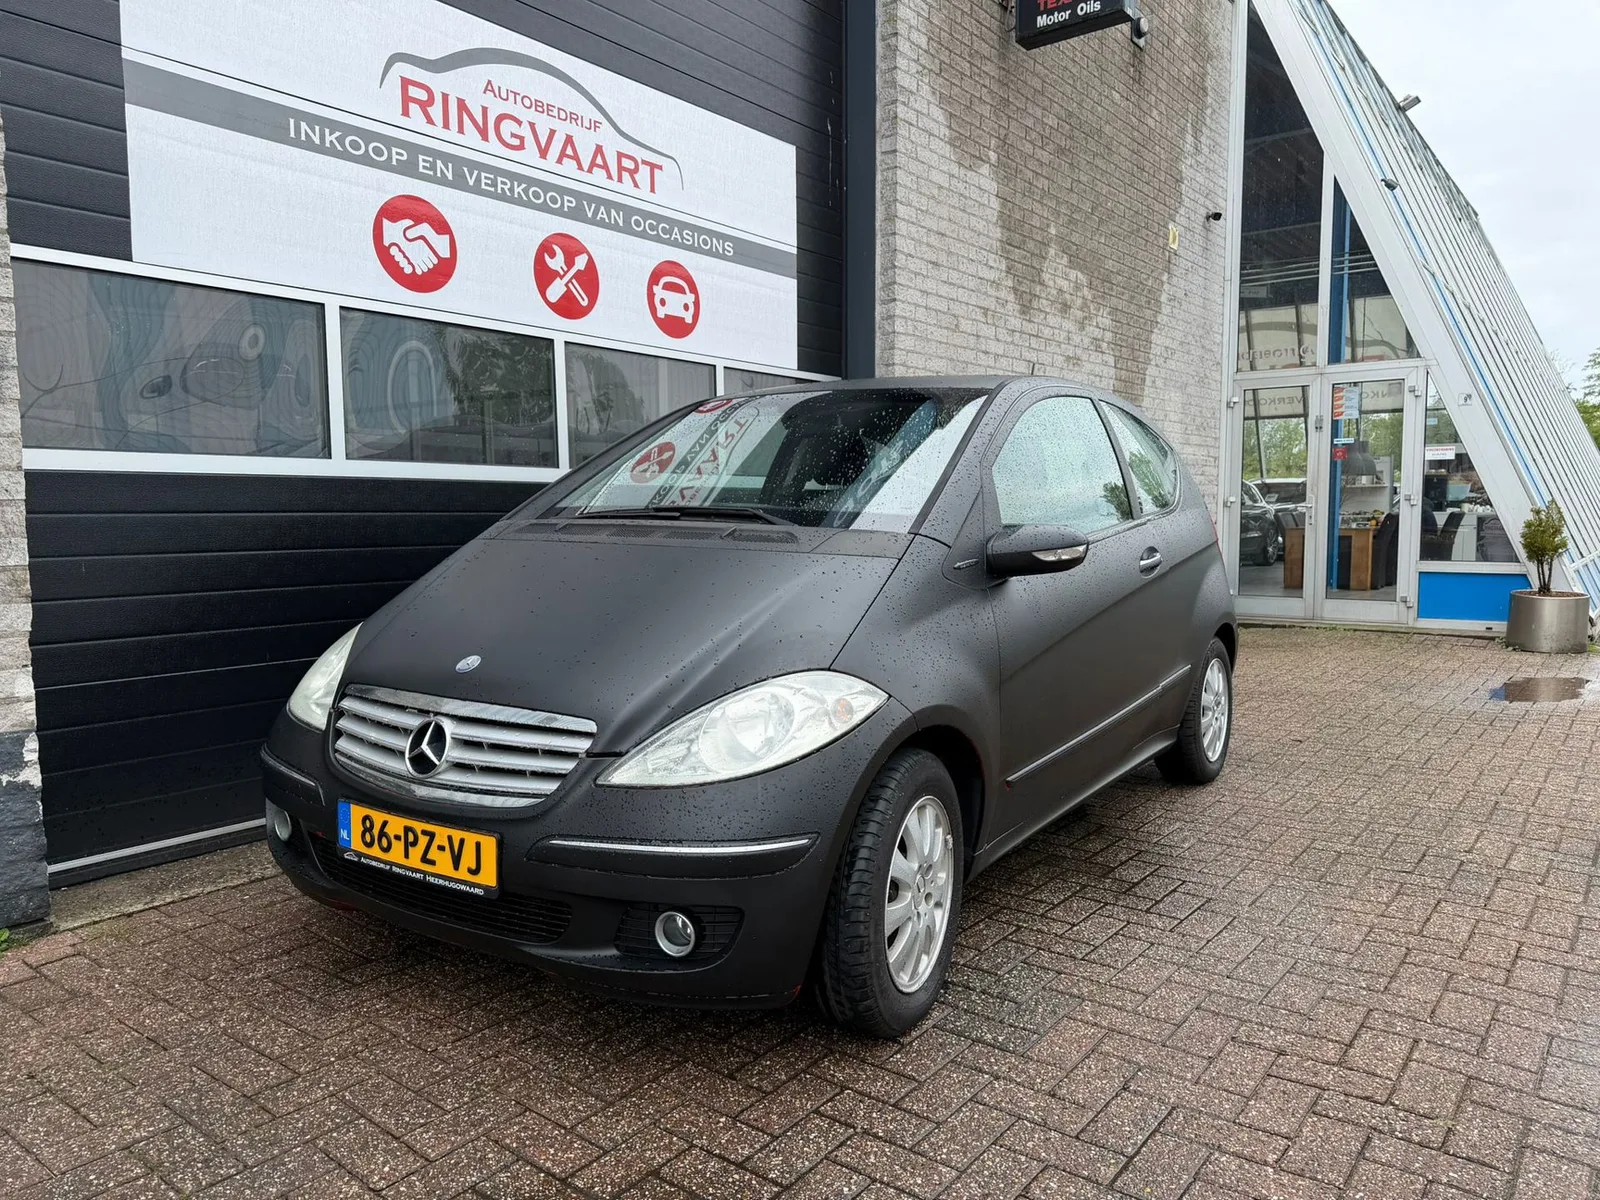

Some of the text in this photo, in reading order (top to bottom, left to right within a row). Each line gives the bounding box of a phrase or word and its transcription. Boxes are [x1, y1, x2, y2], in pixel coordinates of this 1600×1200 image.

[1037, 0, 1101, 27] Motor Oils
[483, 79, 602, 133] AUTOBEDRIJF
[399, 75, 663, 195] RINGVAART
[288, 117, 735, 257] INKOOP EN VERKOOP VAN OCCASIONS
[340, 828, 350, 841] NL
[360, 814, 482, 876] 86-PZ-VJ
[391, 865, 424, 880] RINGVAART
[425, 875, 484, 896] HEERHUGOWAARD
